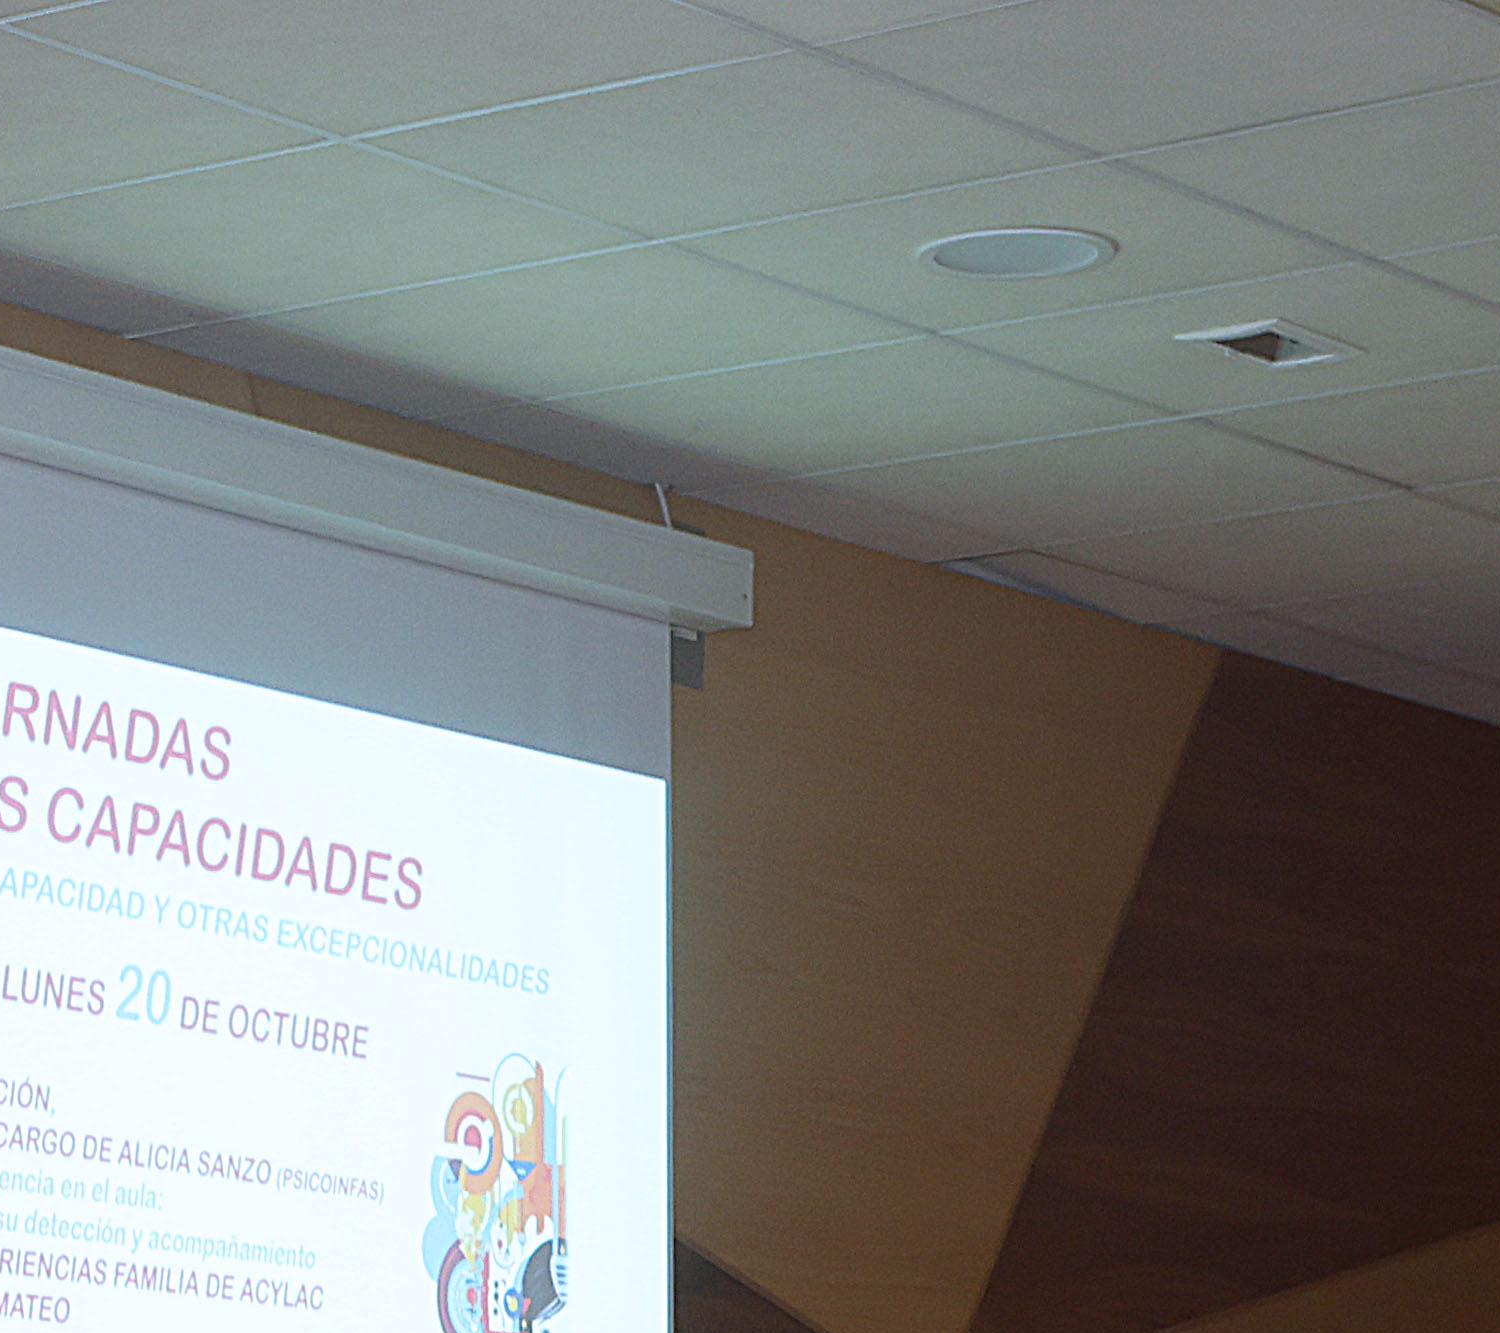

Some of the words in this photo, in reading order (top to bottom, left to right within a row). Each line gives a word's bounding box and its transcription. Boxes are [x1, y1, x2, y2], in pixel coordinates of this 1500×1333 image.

[47, 787, 423, 910] CAPACIDADES
[154, 894, 171, 924] Y
[177, 900, 269, 943] OTRAS
[276, 918, 551, 996] EXCEPCIONALIDADES
[2, 964, 106, 1016] LUNES
[115, 963, 172, 1026] 20
[180, 995, 221, 1035] DE
[228, 1003, 370, 1059] OCTUBRE
[60, 1178, 85, 1200] en
[91, 1177, 110, 1203] el
[114, 1183, 164, 1210] aula:
[82, 1134, 113, 1163] DE
[117, 1138, 191, 1174] ALICIA
[197, 1149, 272, 1185] SANZO
[275, 1166, 385, 1206] (PSICOINFAS)
[24, 1210, 126, 1246] detección
[131, 1227, 144, 1254] y
[147, 1228, 317, 1270] acompañamiento
[113, 1261, 200, 1297] FAMILIA
[205, 1272, 236, 1301] DE
[239, 1276, 325, 1311] ACYLAC
